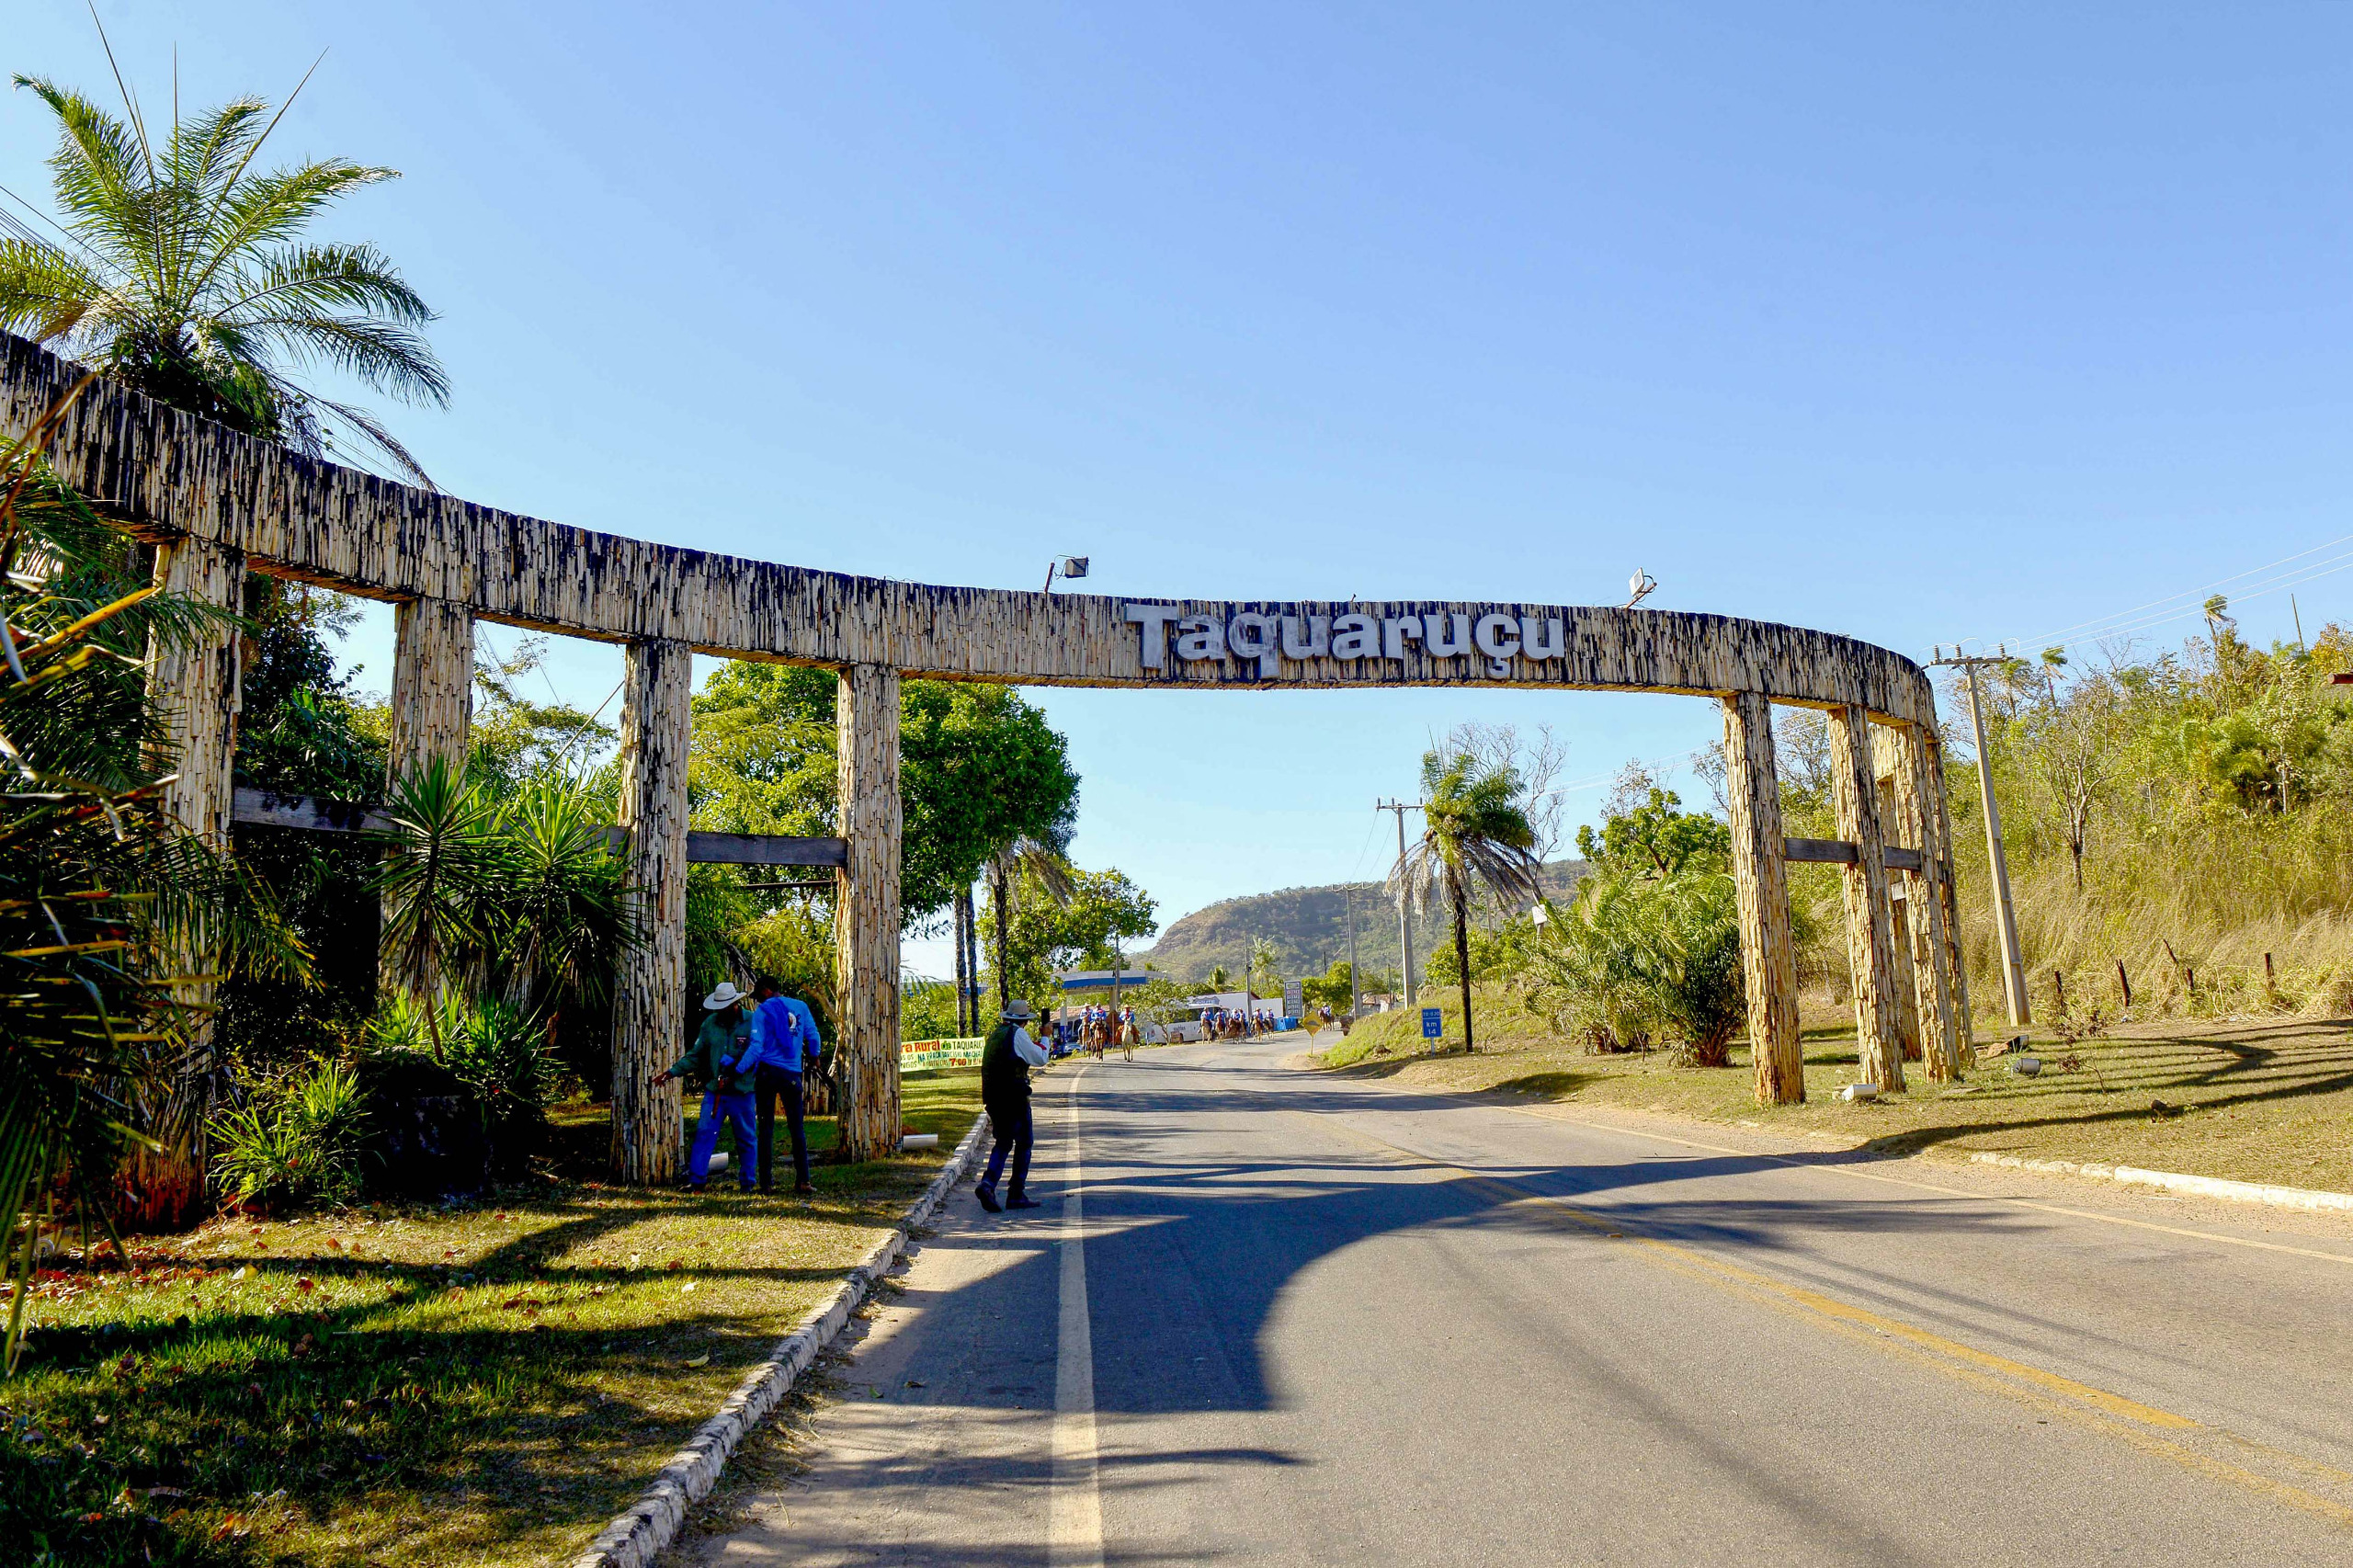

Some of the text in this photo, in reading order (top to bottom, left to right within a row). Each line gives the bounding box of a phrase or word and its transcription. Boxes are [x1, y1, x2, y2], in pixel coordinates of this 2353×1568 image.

[1124, 603, 1565, 679] Taquaruçu
[915, 1040, 940, 1052] Rural
[941, 1040, 951, 1050] de
[949, 1058, 967, 1066] 7:00
